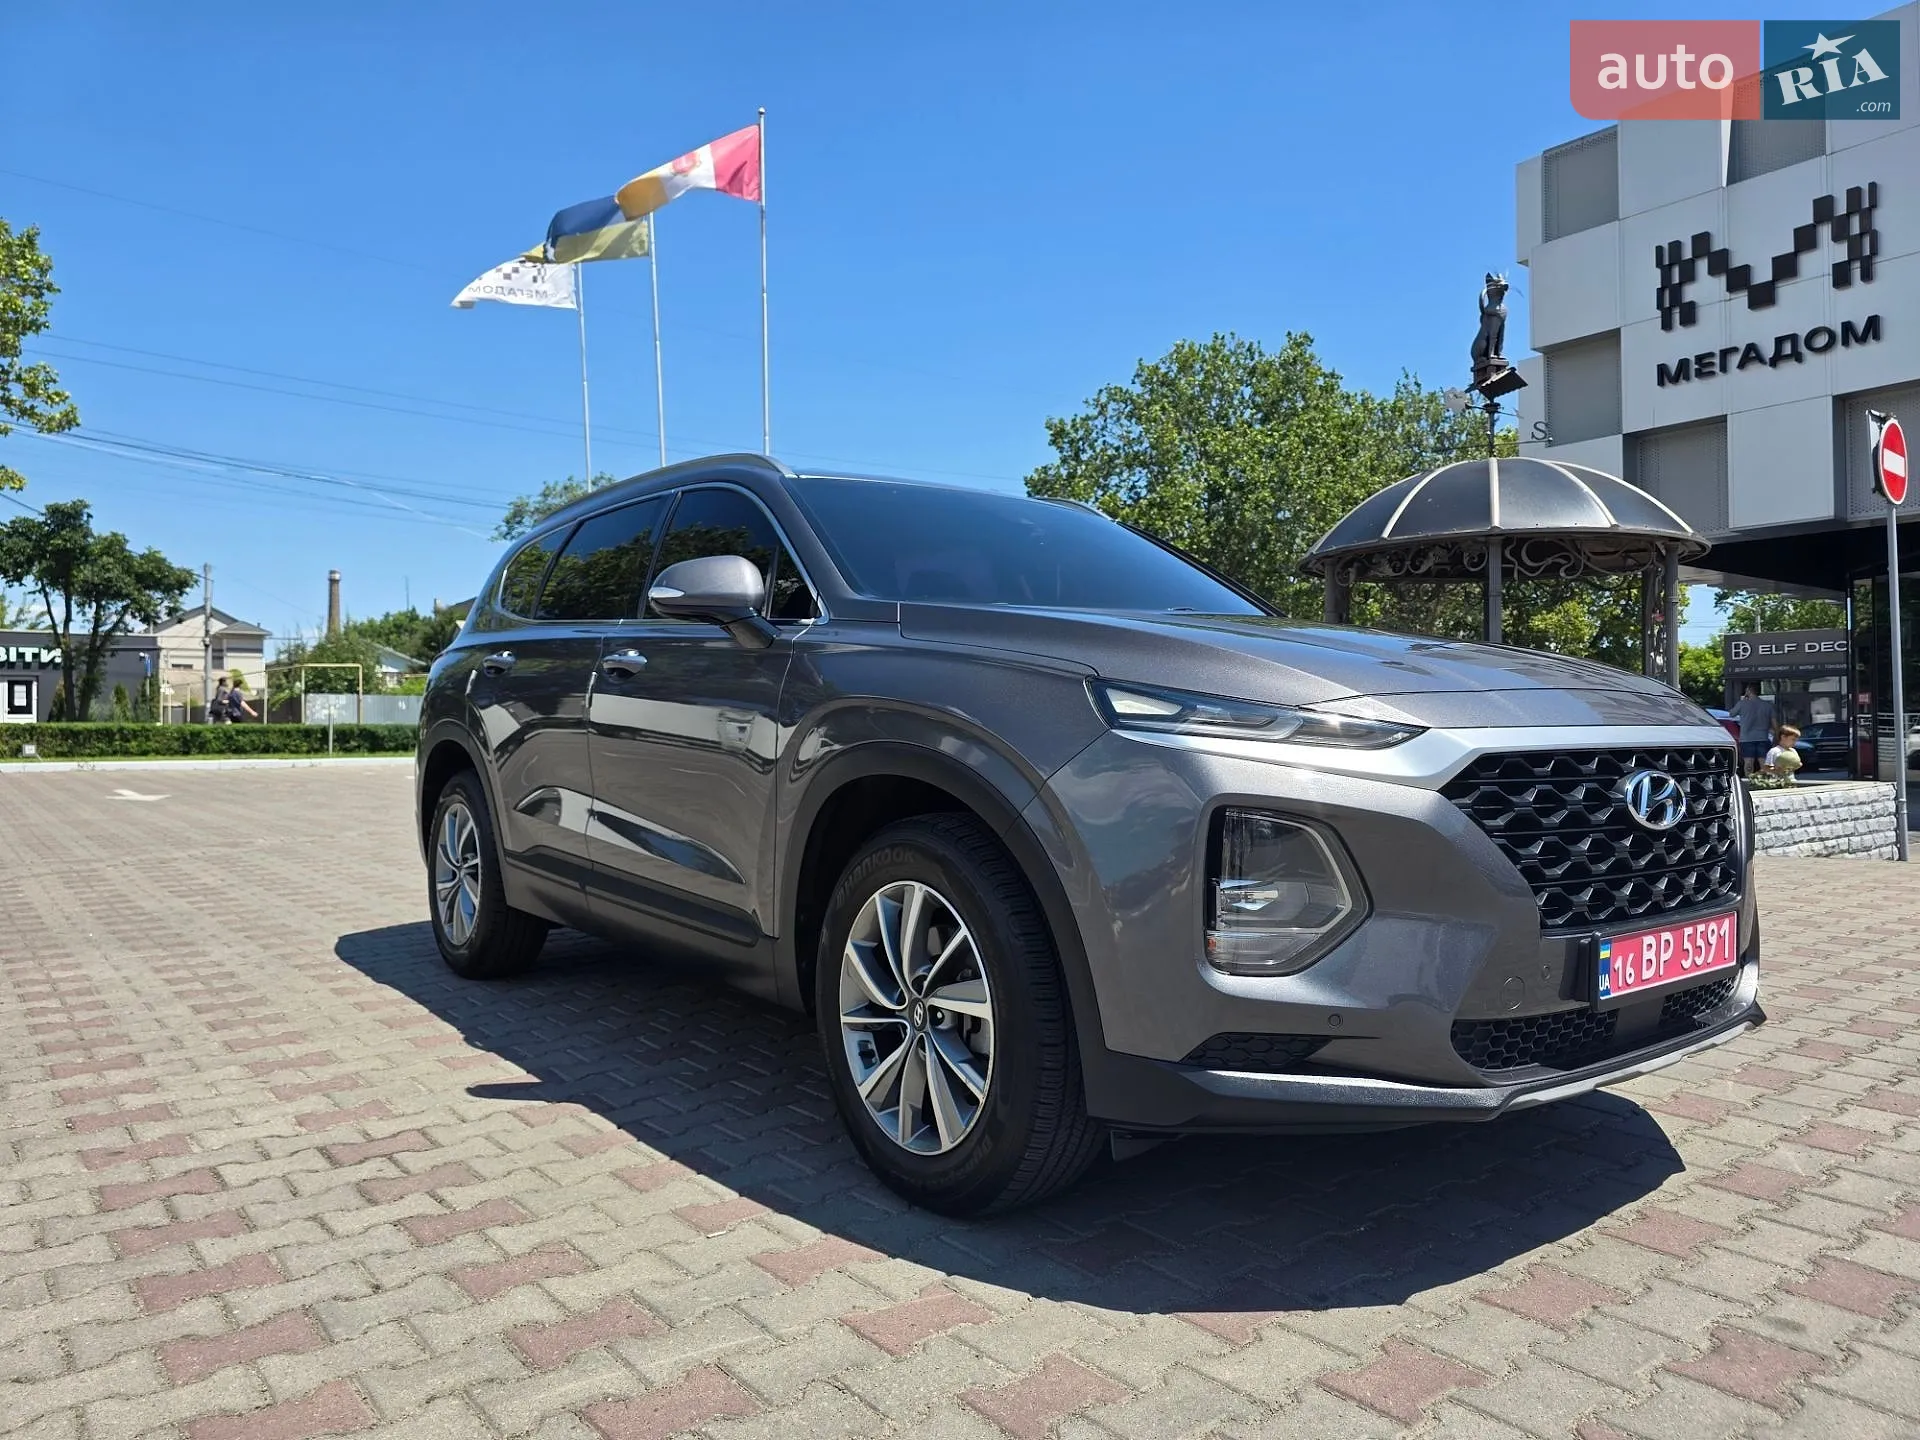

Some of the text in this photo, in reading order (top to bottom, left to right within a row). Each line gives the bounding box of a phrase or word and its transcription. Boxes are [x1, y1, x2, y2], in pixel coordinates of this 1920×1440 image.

[1656, 314, 1881, 387] МЕГАДОМ
[1759, 640, 1848, 655] ELF DEC
[1614, 918, 1730, 987] 16 BP 5591
[1598, 974, 1611, 991] UA
